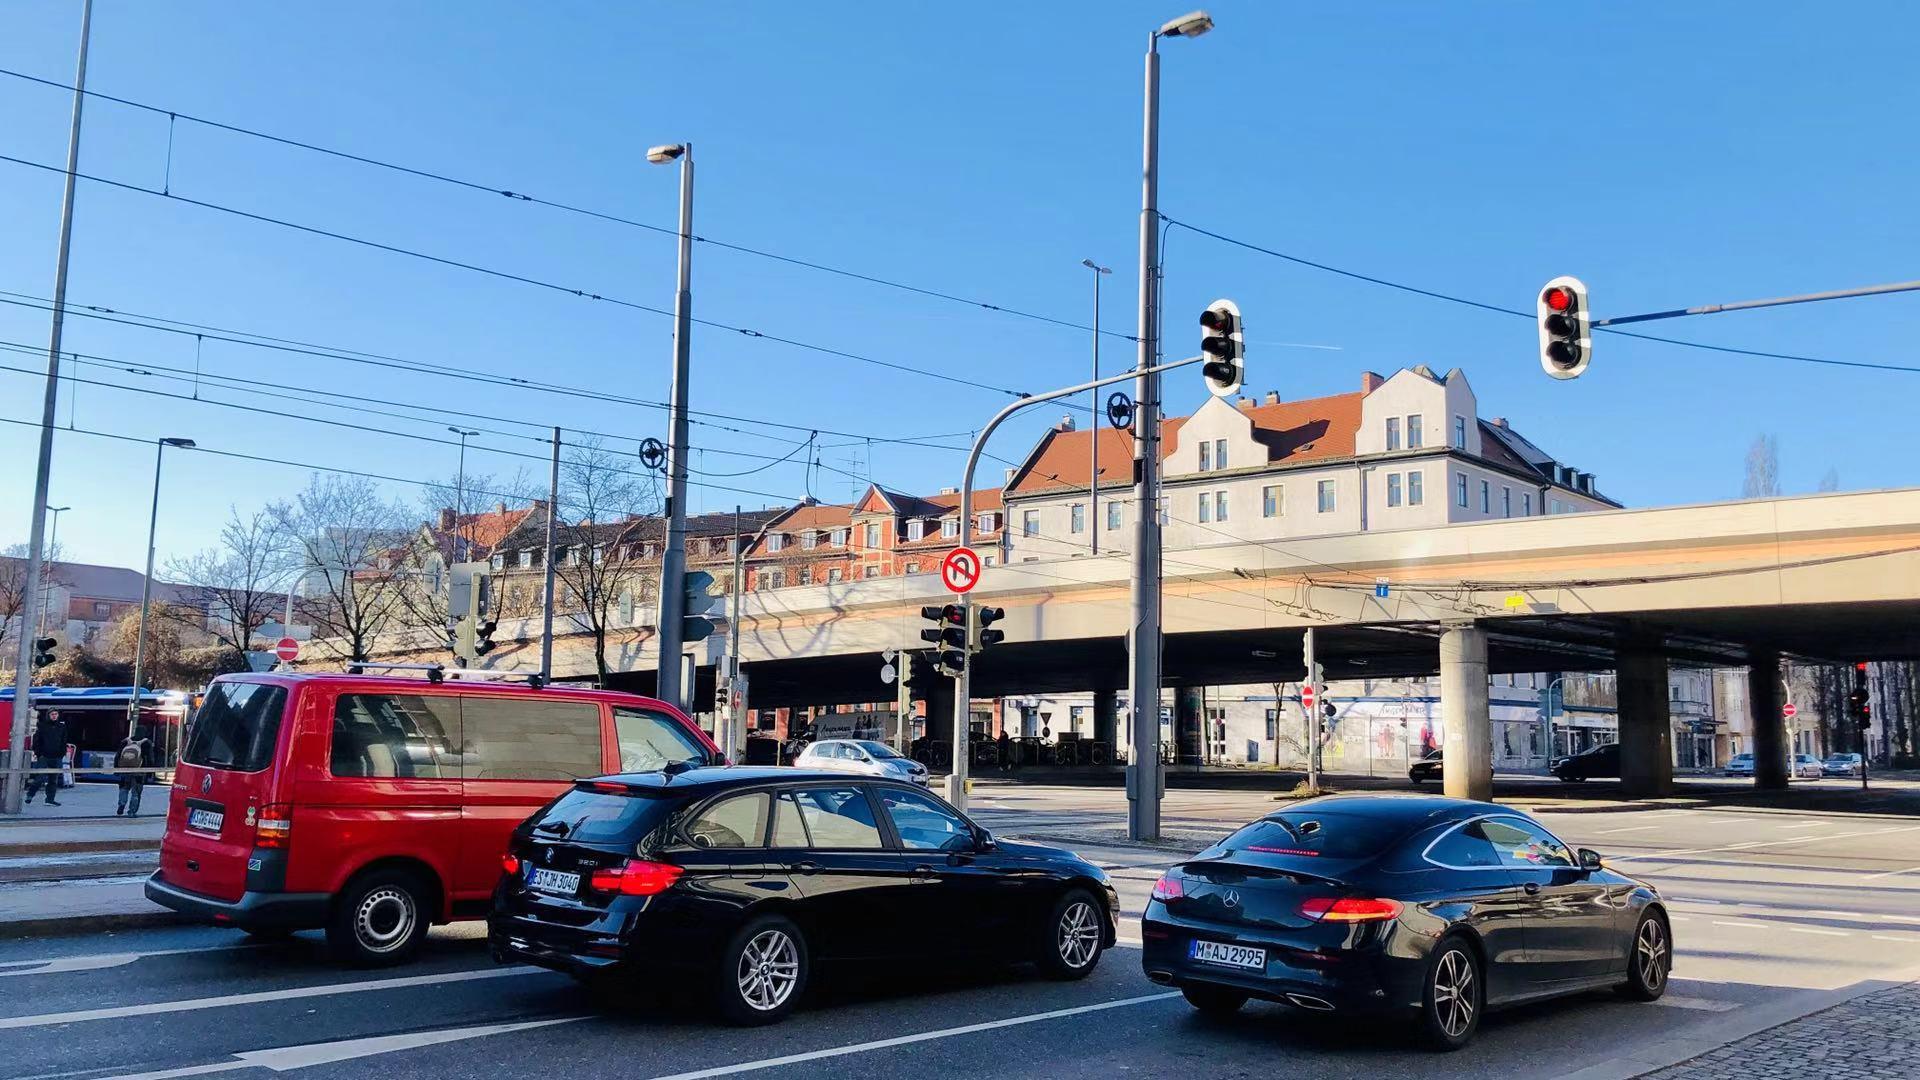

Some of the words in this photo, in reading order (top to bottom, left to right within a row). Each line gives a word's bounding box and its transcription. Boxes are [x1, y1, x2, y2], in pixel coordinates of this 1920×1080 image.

[533, 868, 544, 886] ES
[546, 872, 558, 888] JH
[558, 874, 579, 891] 3040
[1196, 942, 1206, 958] M
[1211, 945, 1229, 961] AJ
[1230, 948, 1264, 966] 2995
